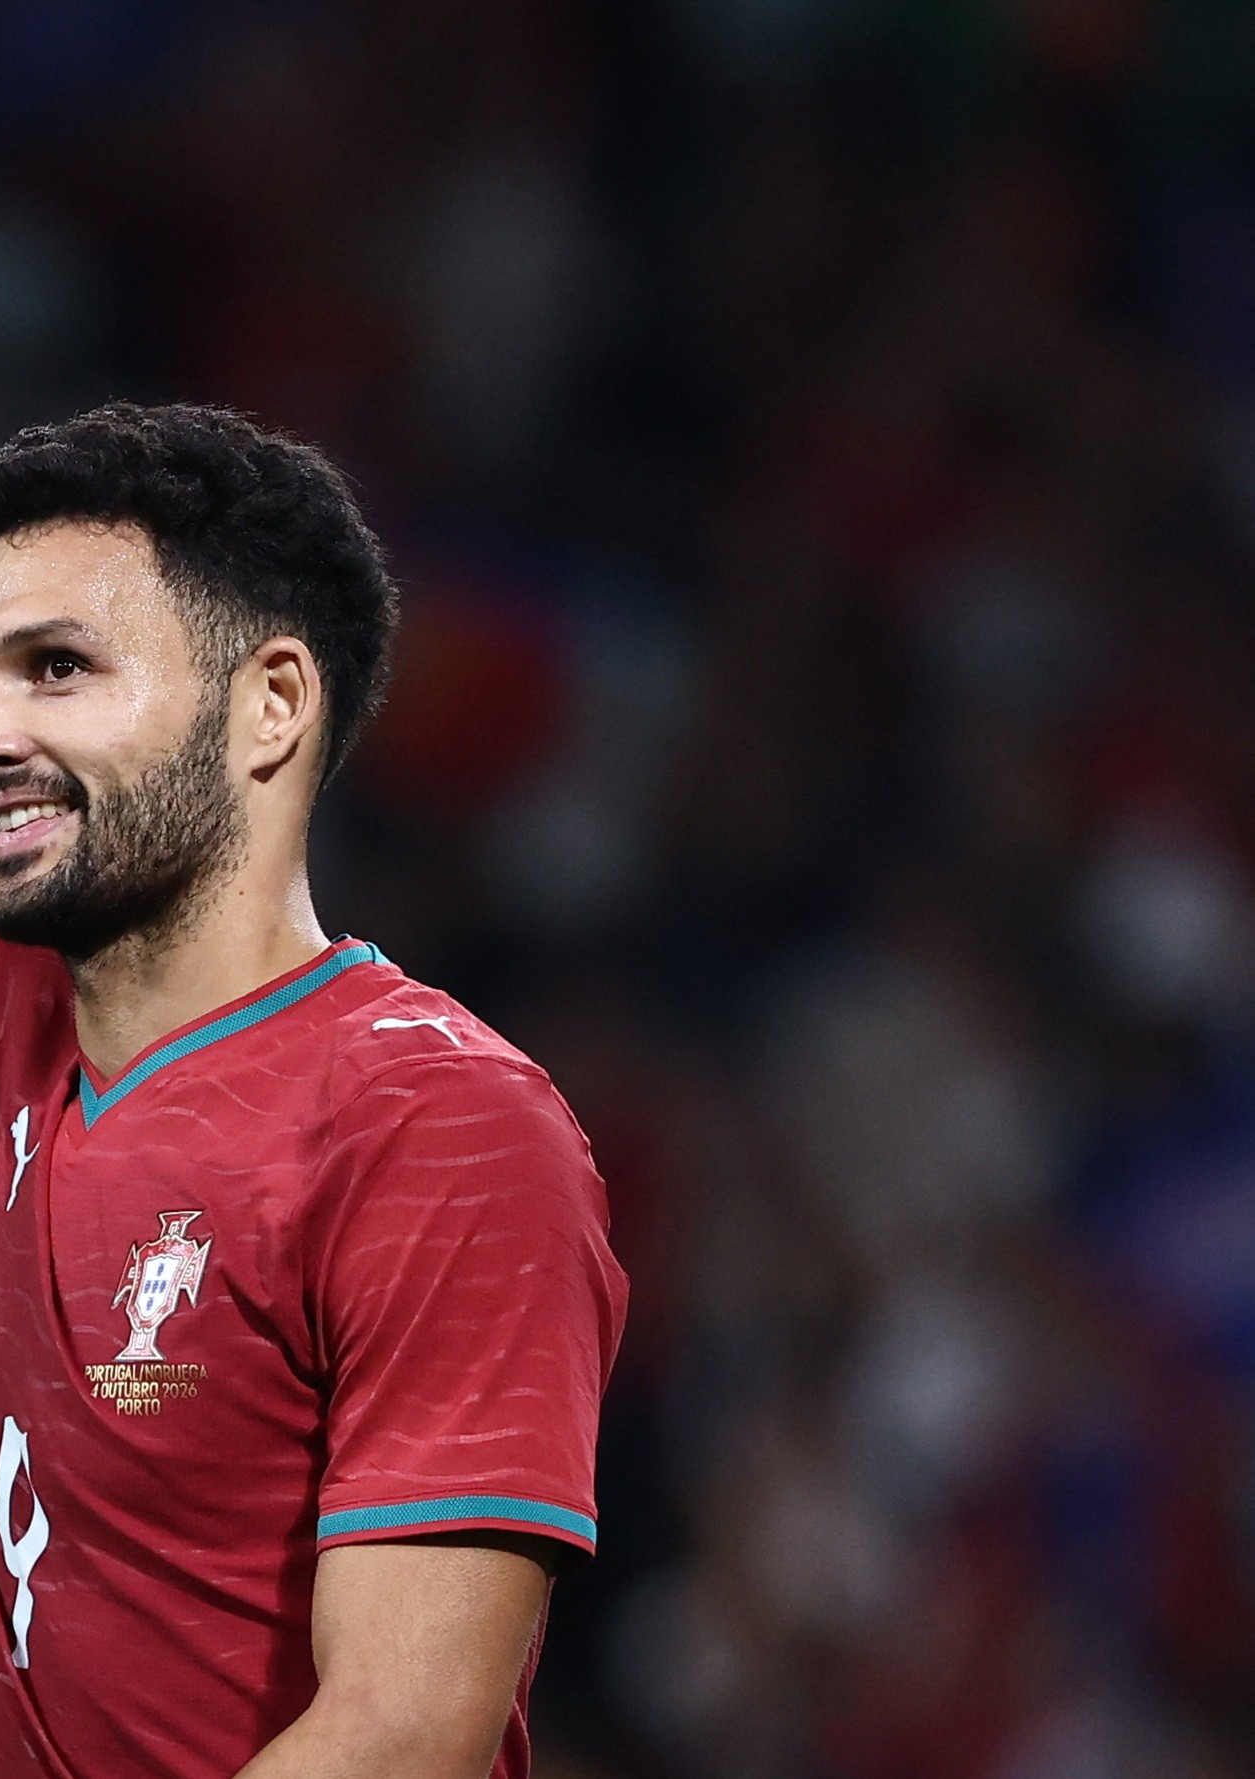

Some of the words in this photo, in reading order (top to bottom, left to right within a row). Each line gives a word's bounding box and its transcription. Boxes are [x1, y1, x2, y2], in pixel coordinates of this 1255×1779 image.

[91, 1383, 99, 1398] 4
[100, 1382, 159, 1398] OUTUBRO
[162, 1382, 198, 1398] 2026
[116, 1399, 161, 1416] PORTO
